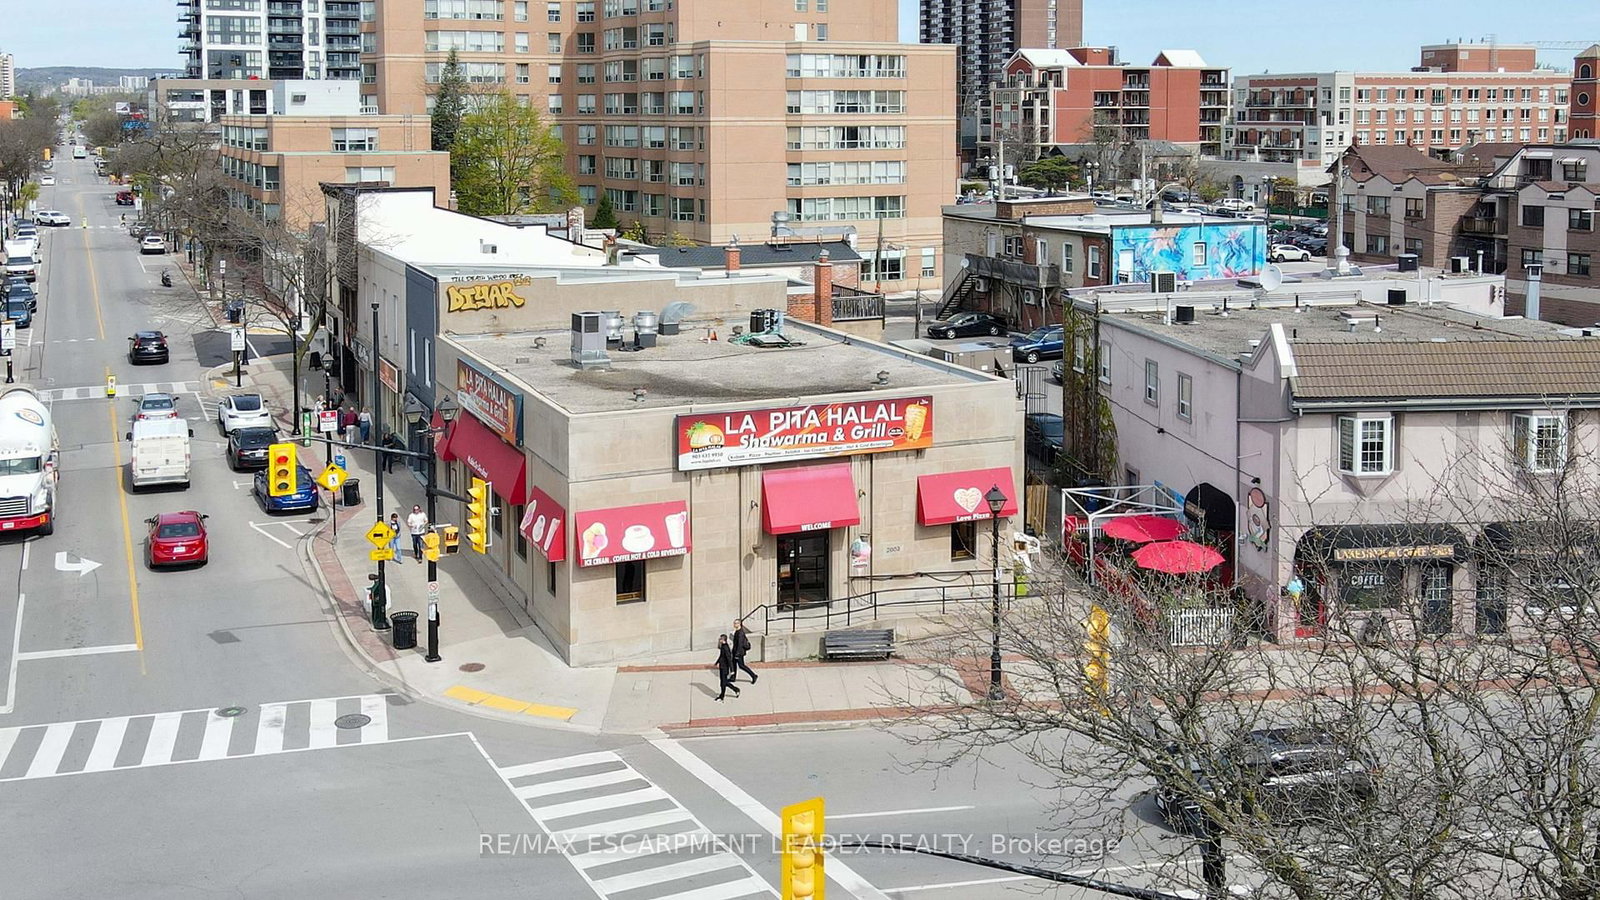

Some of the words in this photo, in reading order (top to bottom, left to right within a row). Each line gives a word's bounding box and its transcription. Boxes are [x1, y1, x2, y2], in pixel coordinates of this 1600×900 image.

[446, 282, 526, 313] DIYAR
[466, 368, 474, 386] LA
[488, 382, 508, 410] HALAL
[725, 414, 757, 435] LA
[770, 409, 822, 432] PITA
[828, 403, 904, 426] HALAL
[740, 431, 828, 449] Shawarma
[833, 427, 845, 442] &
[851, 422, 887, 439] Grill
[801, 522, 831, 531] WELCOME
[661, 548, 687, 557] BEVERAGES
[1351, 575, 1385, 585] COFFEE
